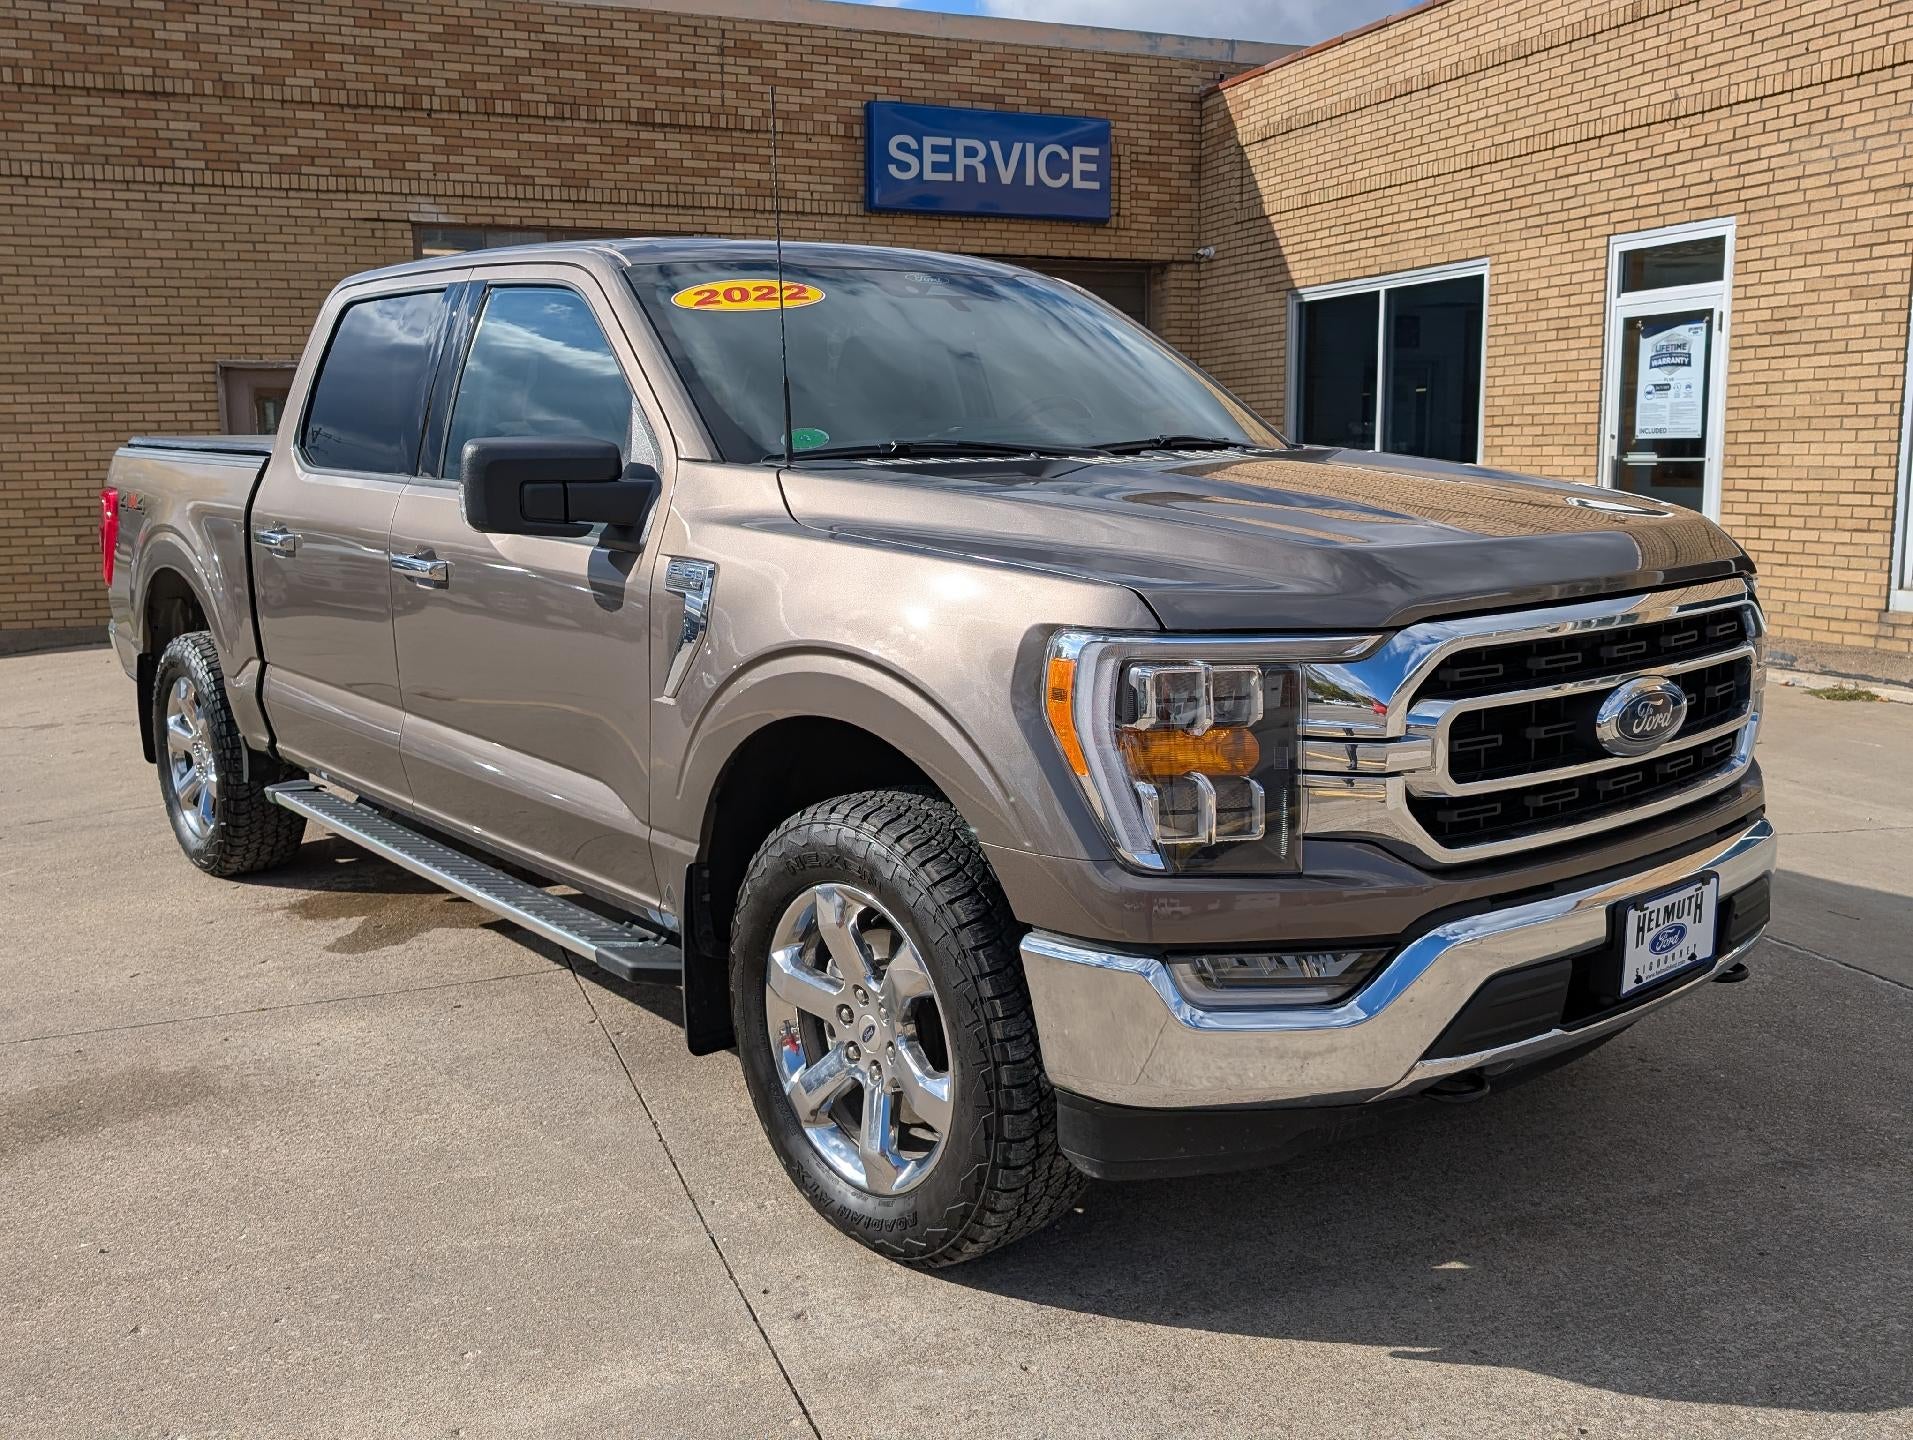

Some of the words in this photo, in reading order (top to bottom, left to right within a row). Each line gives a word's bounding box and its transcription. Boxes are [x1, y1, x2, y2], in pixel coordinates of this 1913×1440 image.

[888, 134, 1100, 190] SERVICE
[693, 285, 812, 308] 2022
[1651, 356, 1689, 368] WARRANTY
[1655, 343, 1688, 353] LIFETIME
[1632, 698, 1673, 735] Ford
[785, 851, 881, 890] NEXEN
[1635, 890, 1705, 950] HELMUTH
[1655, 927, 1681, 952] Ford
[836, 1202, 918, 1233] ROADIAN
